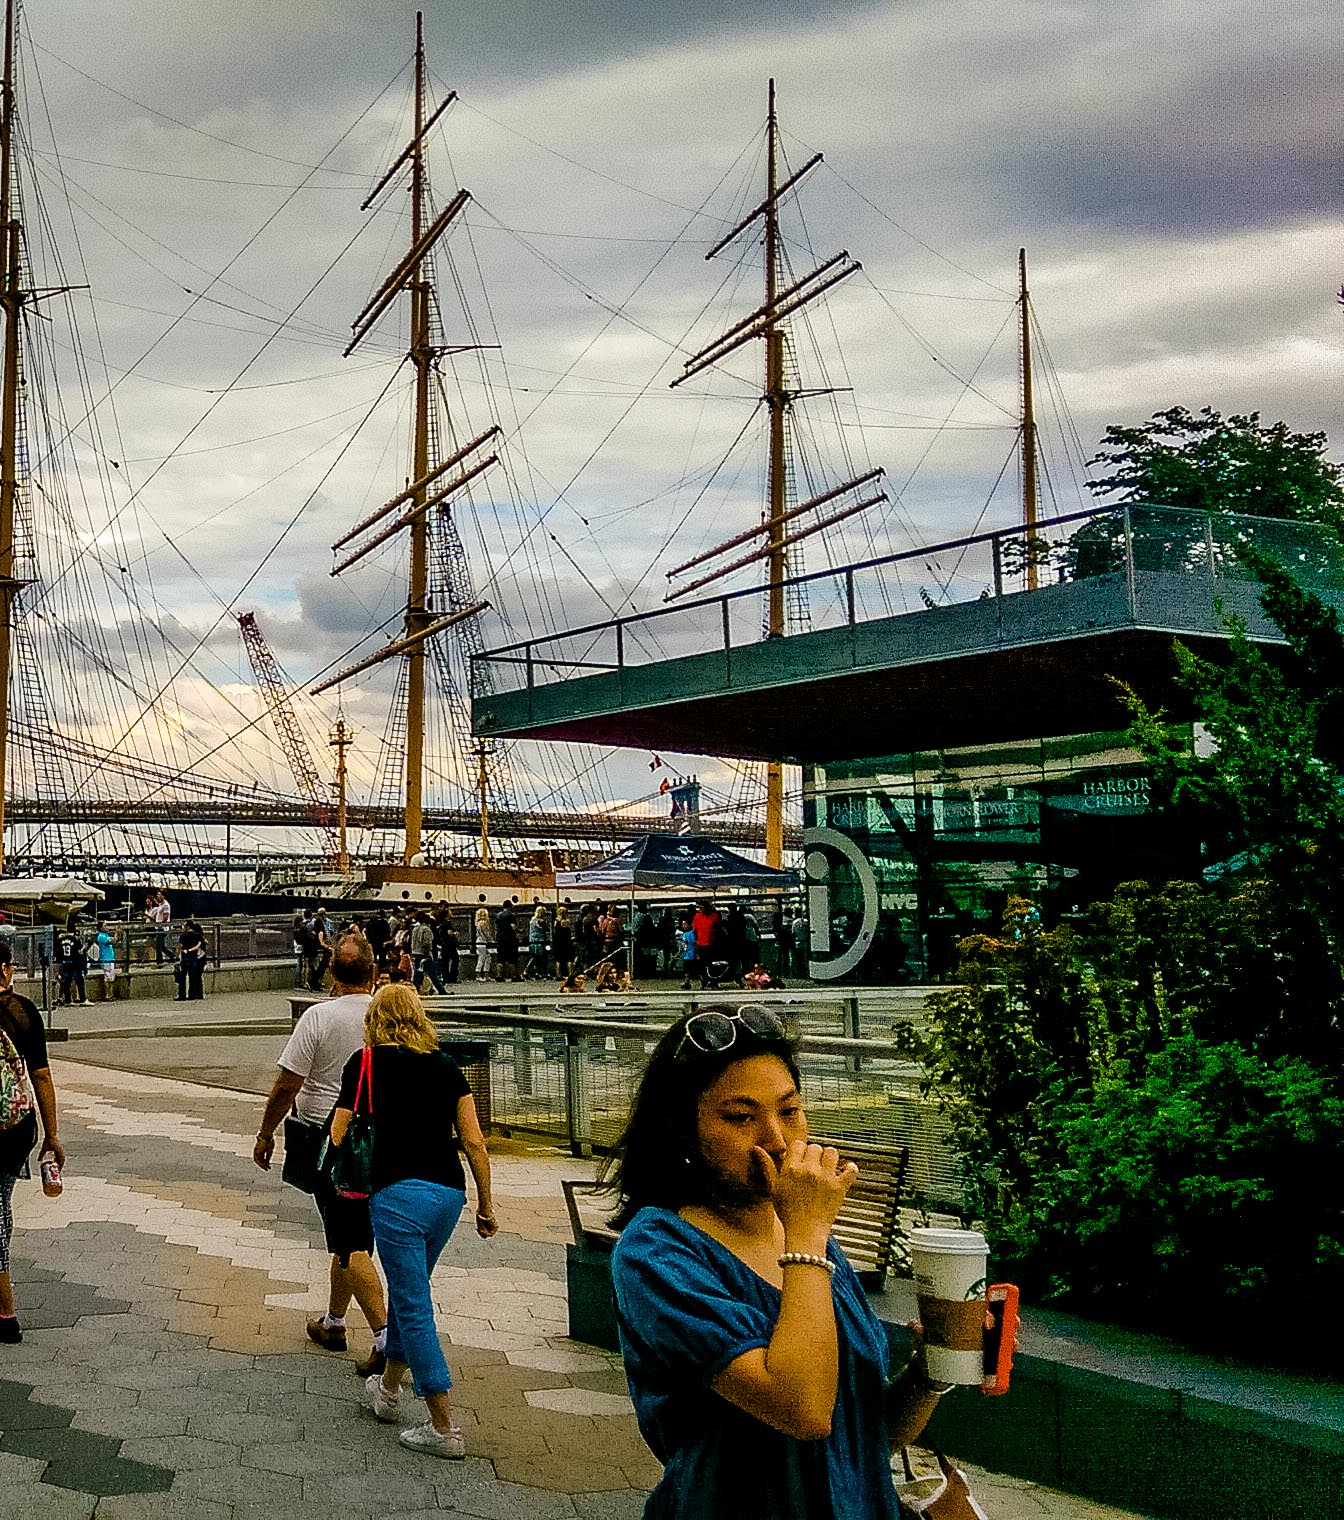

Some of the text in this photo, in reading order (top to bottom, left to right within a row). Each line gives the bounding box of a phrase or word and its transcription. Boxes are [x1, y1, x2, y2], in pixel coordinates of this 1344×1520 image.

[1083, 777, 1152, 795] HARBOR
[1084, 792, 1150, 808] CRUISES
[881, 893, 918, 910] NYC
[63, 945, 70, 956] 19
